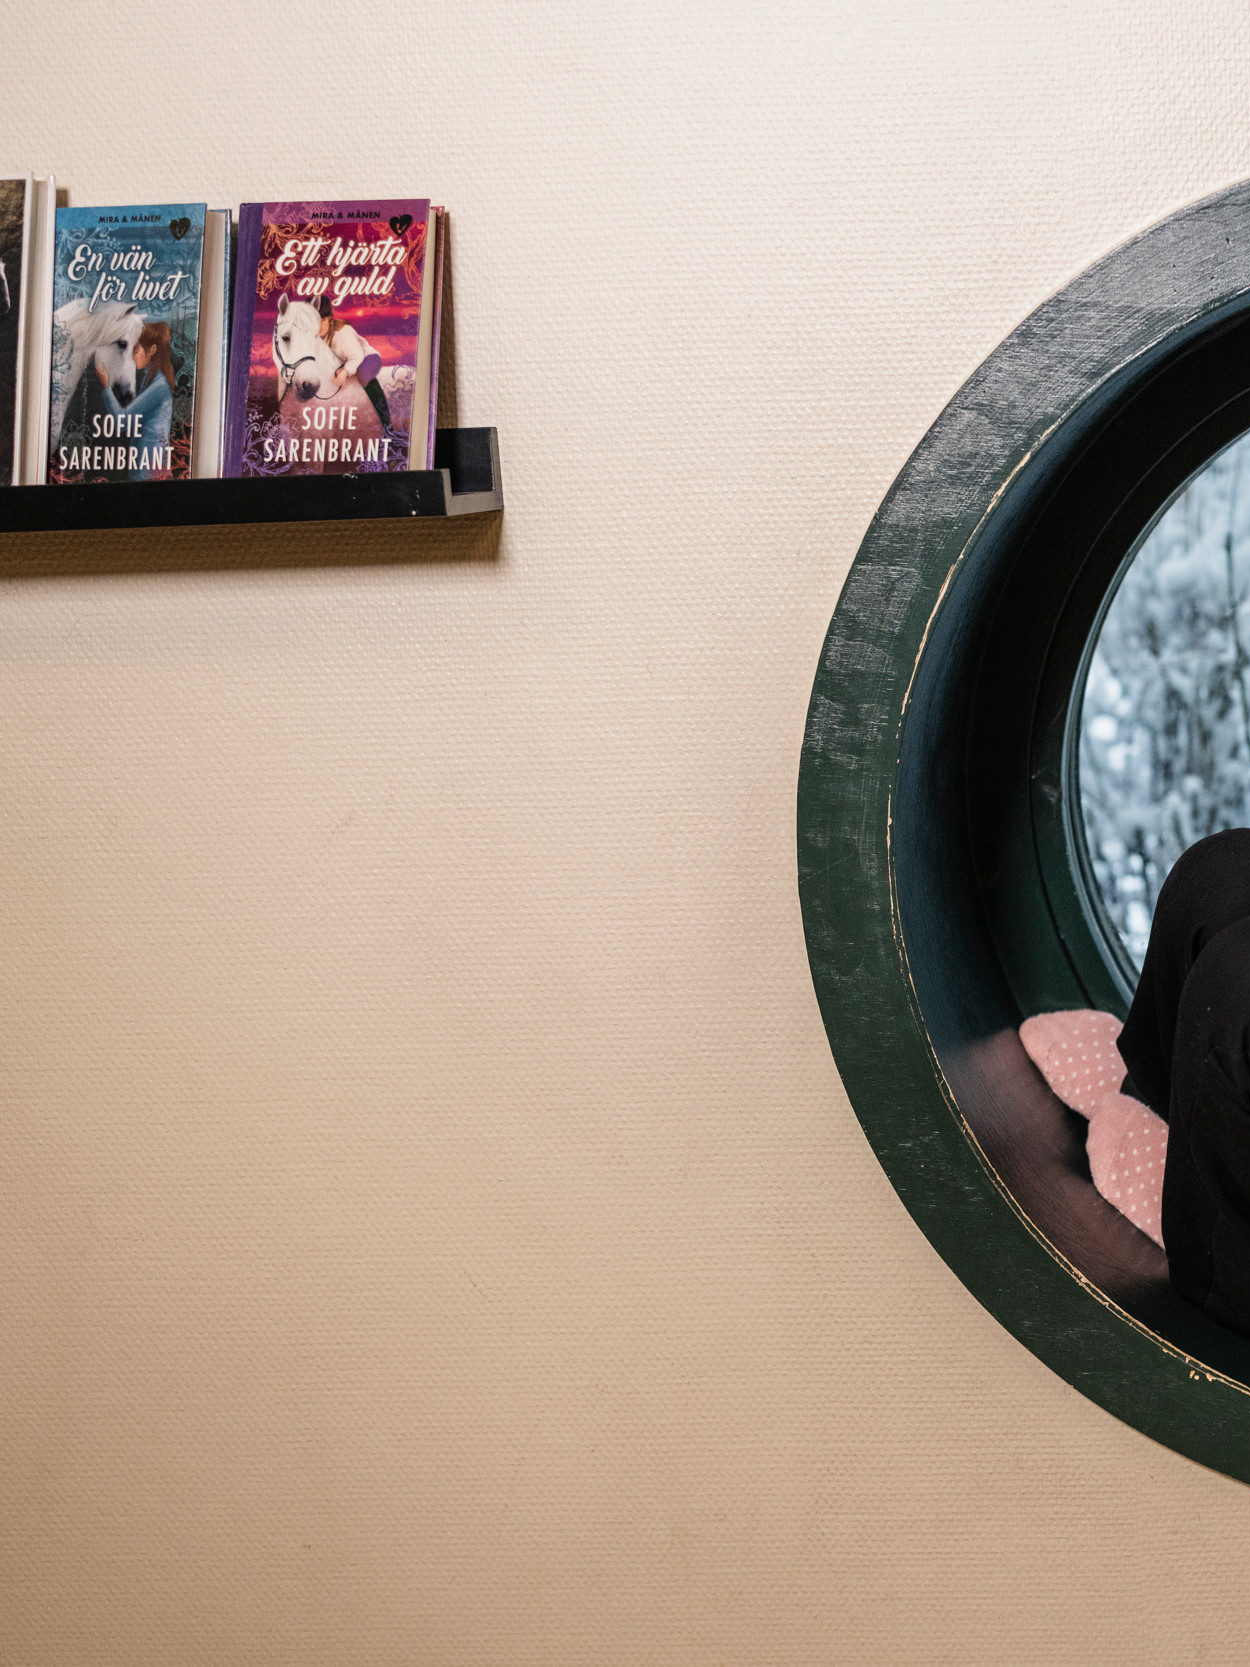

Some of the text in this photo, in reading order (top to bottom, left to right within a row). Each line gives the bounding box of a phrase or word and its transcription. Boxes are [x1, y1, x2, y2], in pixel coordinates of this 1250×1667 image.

[98, 213, 161, 224] MIRA & MÅNEN
[311, 212, 334, 220] MIRA
[347, 210, 381, 219] MÅNEN
[67, 244, 156, 281] En vän
[275, 236, 408, 277] Ett hjärta
[88, 270, 190, 313] för livet
[297, 266, 397, 307] av guld
[92, 413, 144, 438] SOFIE
[301, 406, 358, 430] SOFIE
[59, 446, 175, 471] SARENBRANT
[263, 438, 392, 462] SARENBRANT
